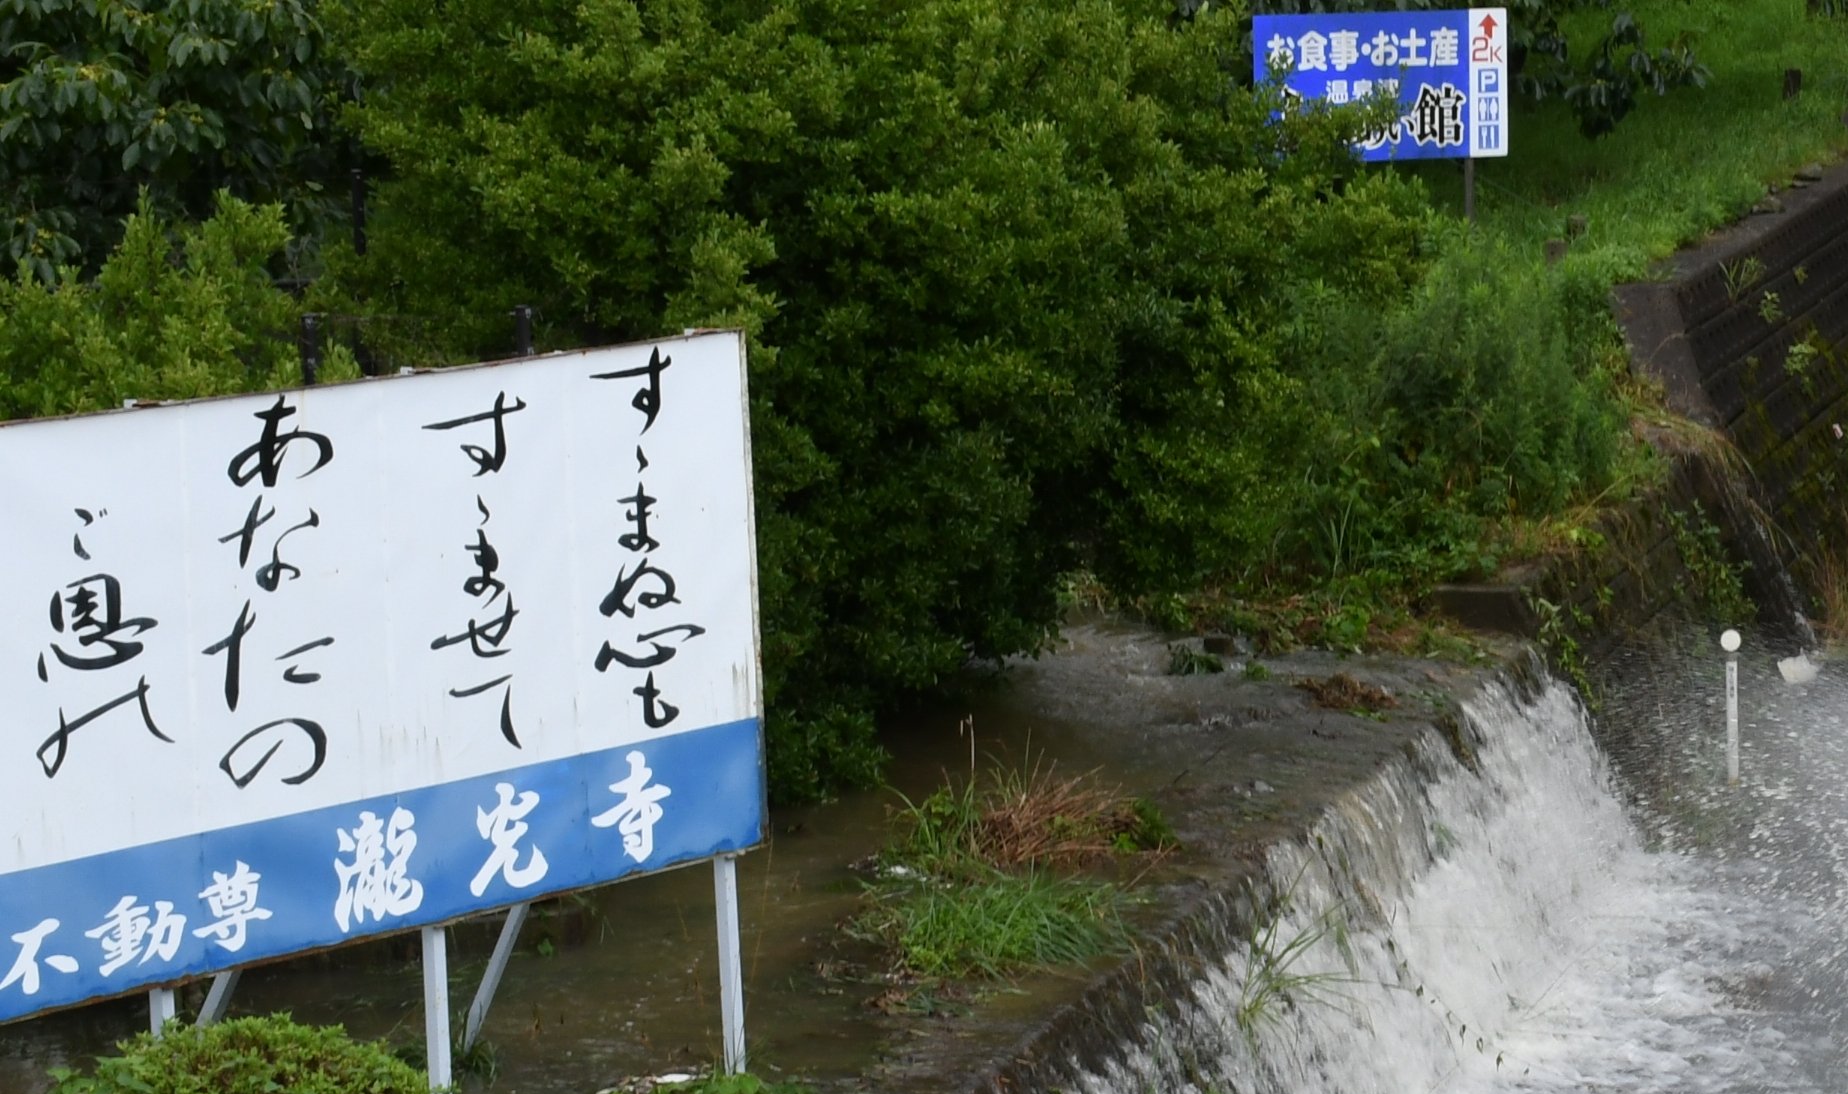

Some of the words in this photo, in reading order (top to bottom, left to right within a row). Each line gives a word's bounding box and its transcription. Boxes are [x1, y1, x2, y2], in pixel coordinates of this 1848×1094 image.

[1267, 27, 1459, 71] お食事・お土産
[201, 394, 334, 788] あなたの
[0, 860, 273, 995] 不動尊
